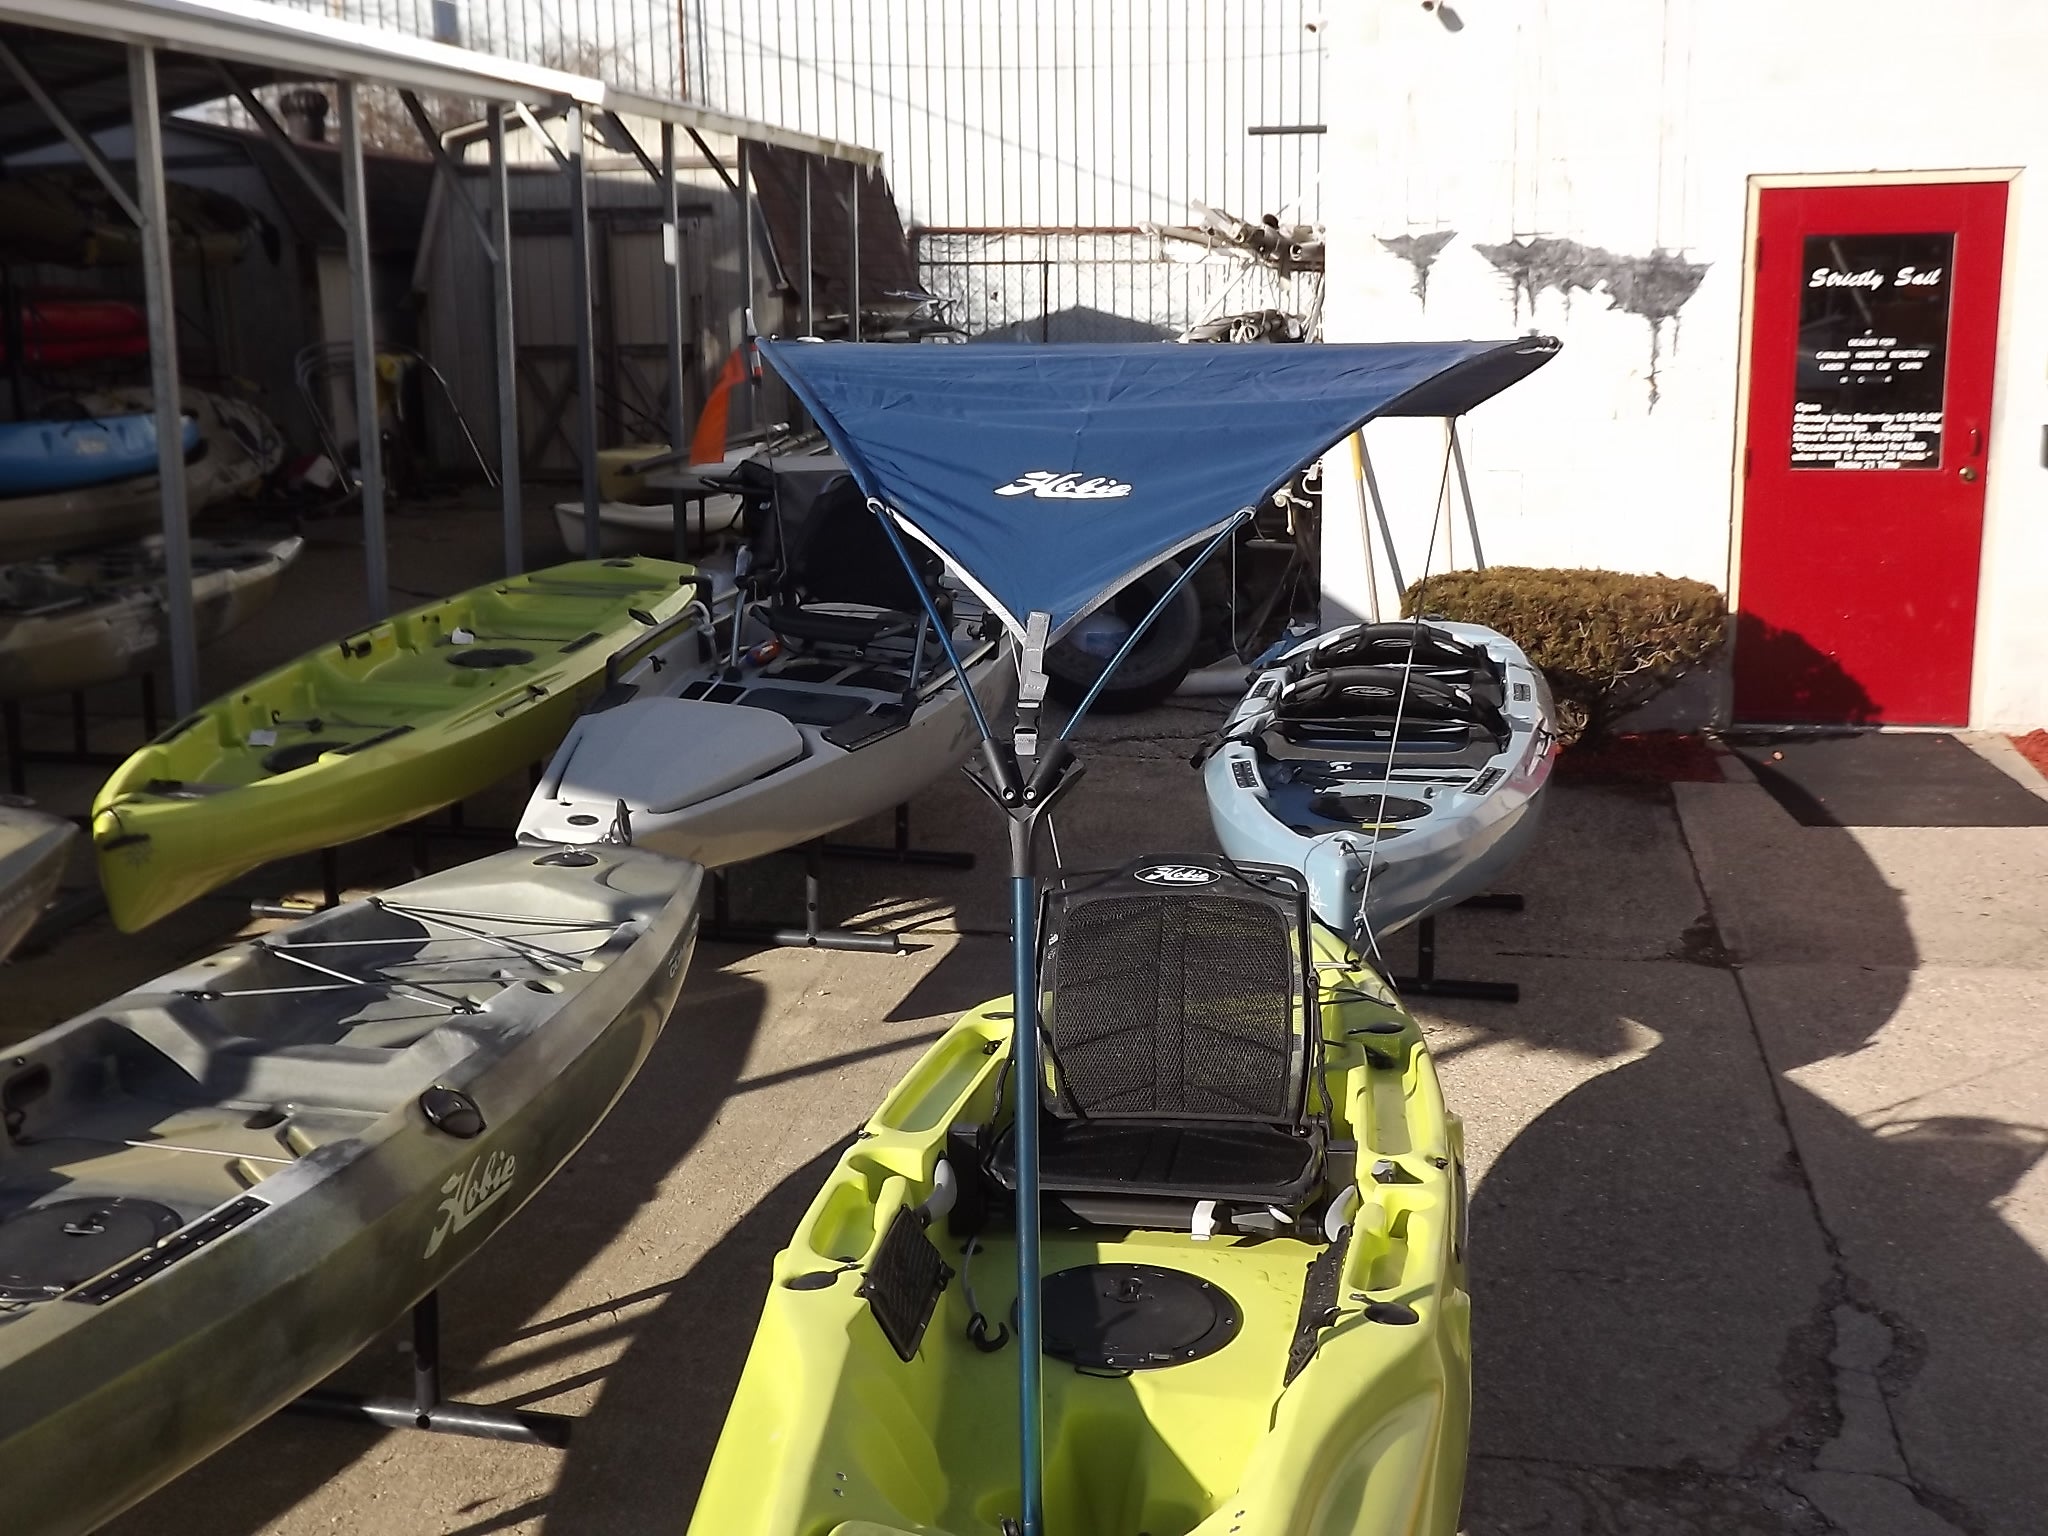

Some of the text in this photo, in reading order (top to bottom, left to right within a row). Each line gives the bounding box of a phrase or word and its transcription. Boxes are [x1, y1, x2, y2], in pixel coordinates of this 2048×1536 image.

[1808, 266, 1942, 291] Strictly Sail
[993, 470, 1133, 499] Hobie
[1144, 867, 1210, 882] Hobie
[423, 1150, 516, 1260] Hobie
